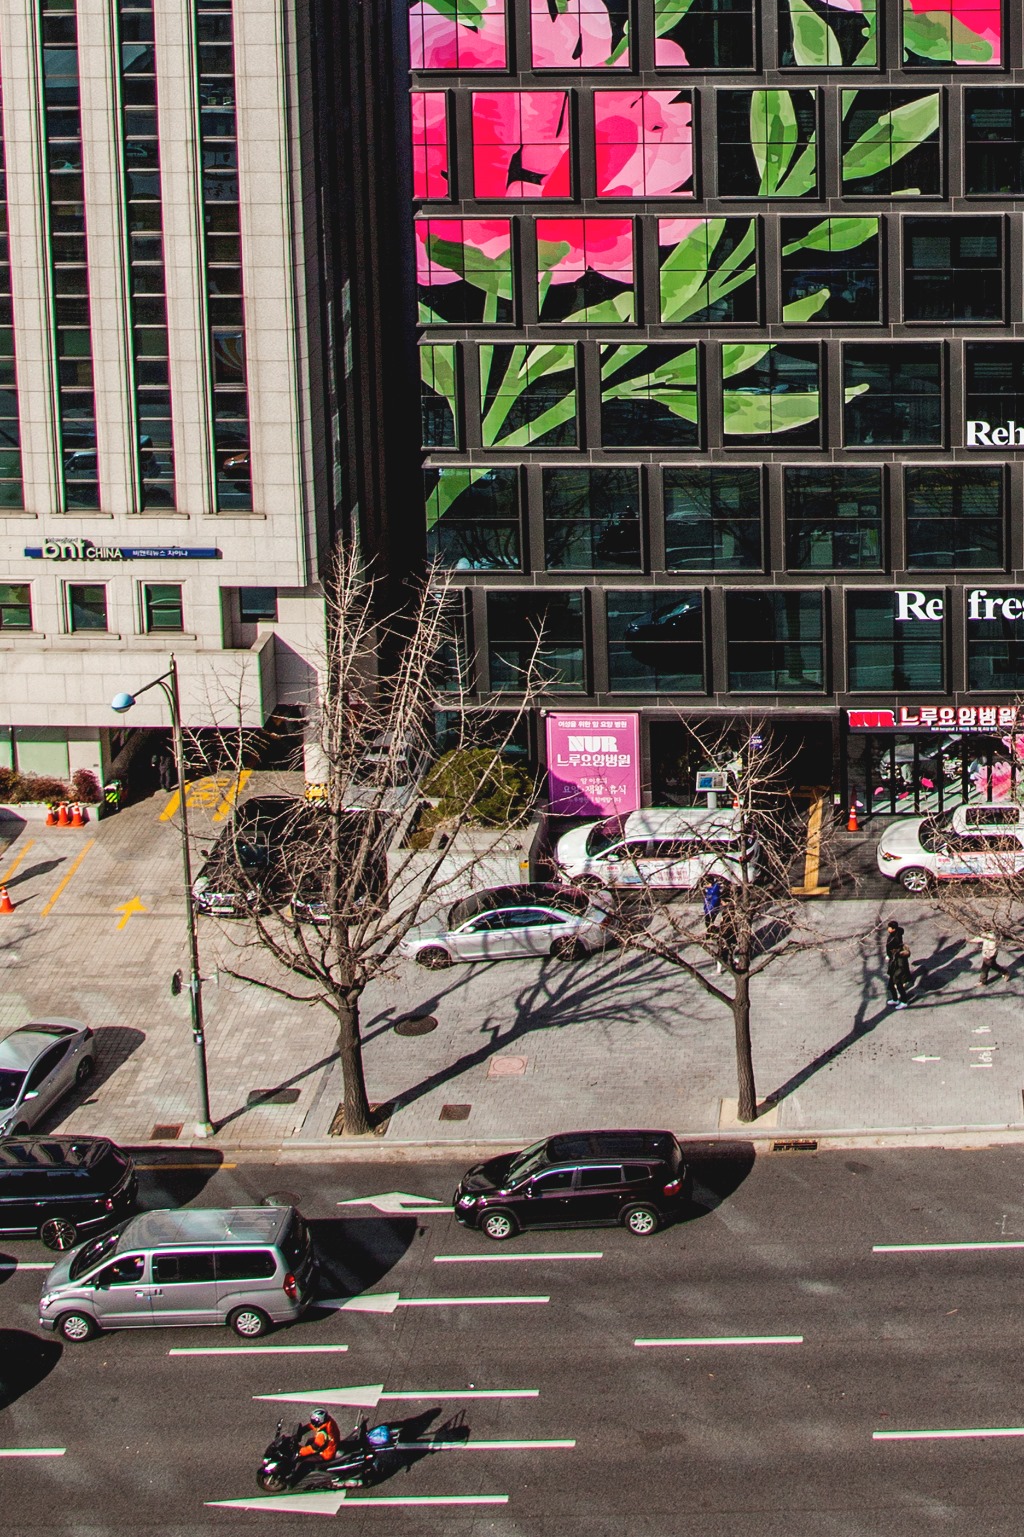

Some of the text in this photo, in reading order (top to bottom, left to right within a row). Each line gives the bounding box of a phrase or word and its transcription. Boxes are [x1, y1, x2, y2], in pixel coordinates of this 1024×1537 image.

[86, 547, 124, 559] CHINA
[567, 736, 618, 753] NUR
[557, 754, 631, 767] 느루요양병원
